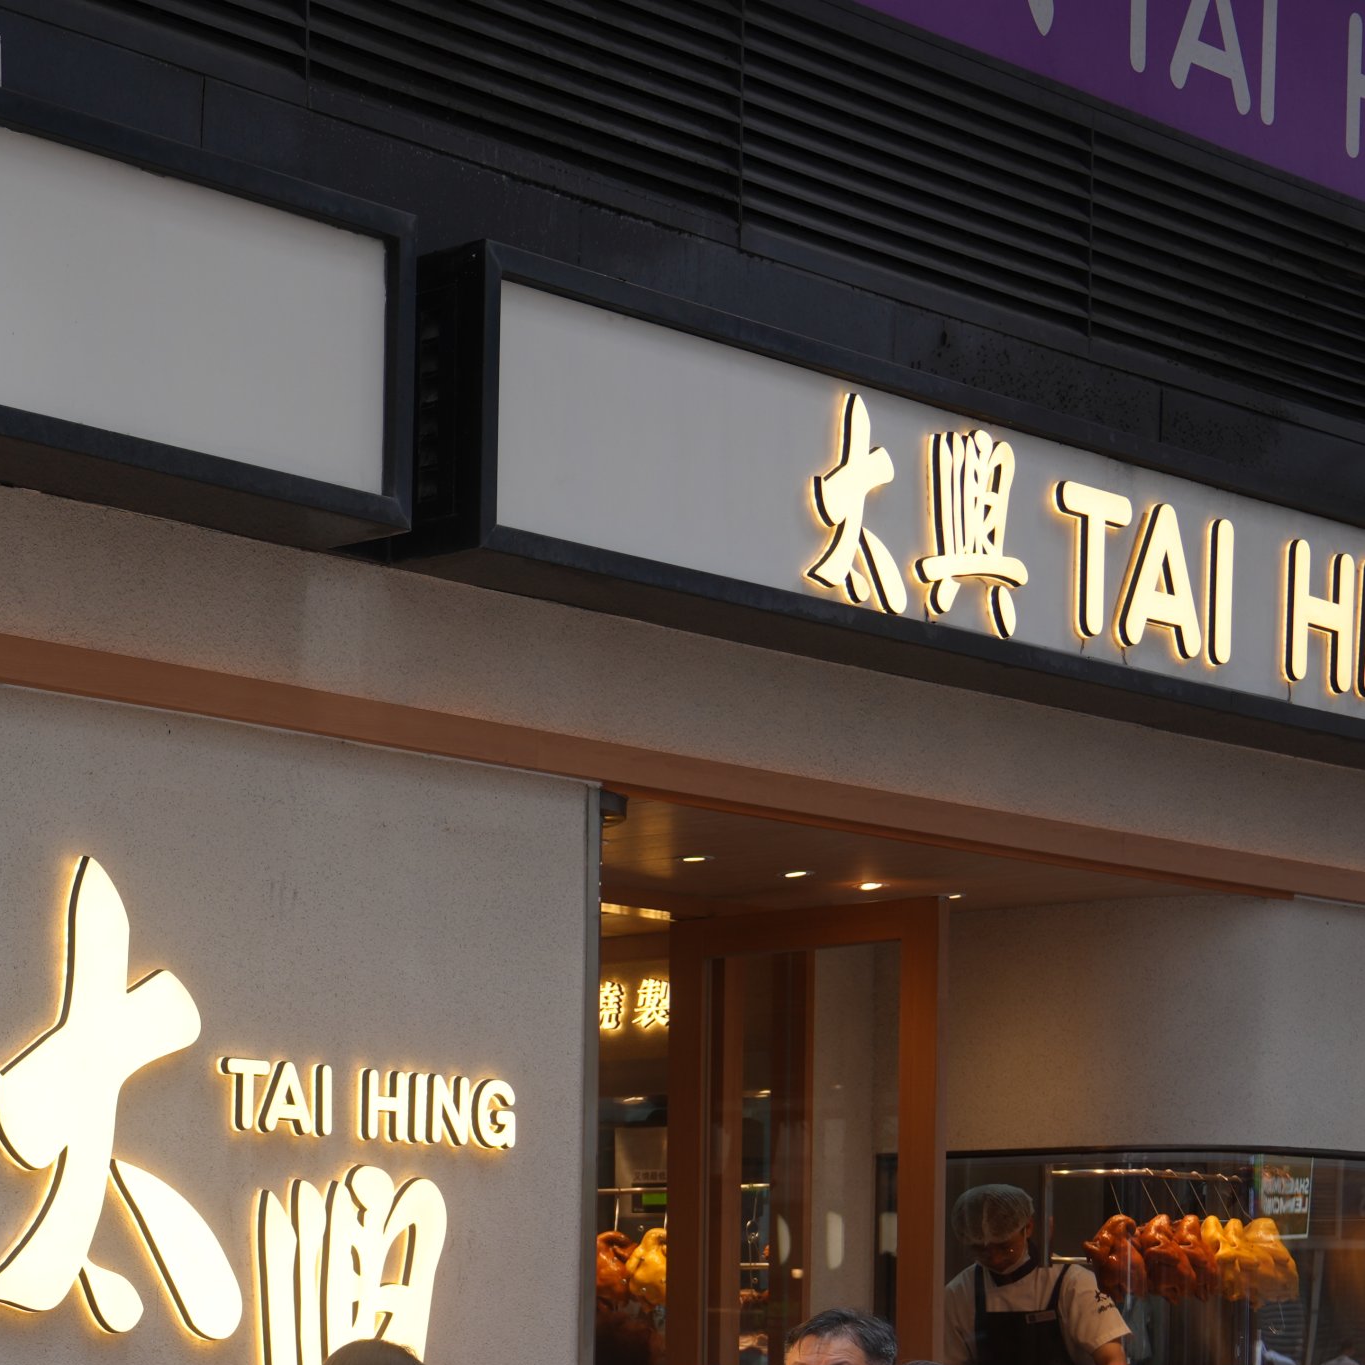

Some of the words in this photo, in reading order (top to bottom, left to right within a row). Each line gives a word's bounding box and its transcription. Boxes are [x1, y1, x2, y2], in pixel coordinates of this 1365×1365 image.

[805, 392, 1029, 639] 太興
[1054, 480, 1235, 666] TAI
[217, 1056, 333, 1137] TAI
[357, 1067, 517, 1149] HING
